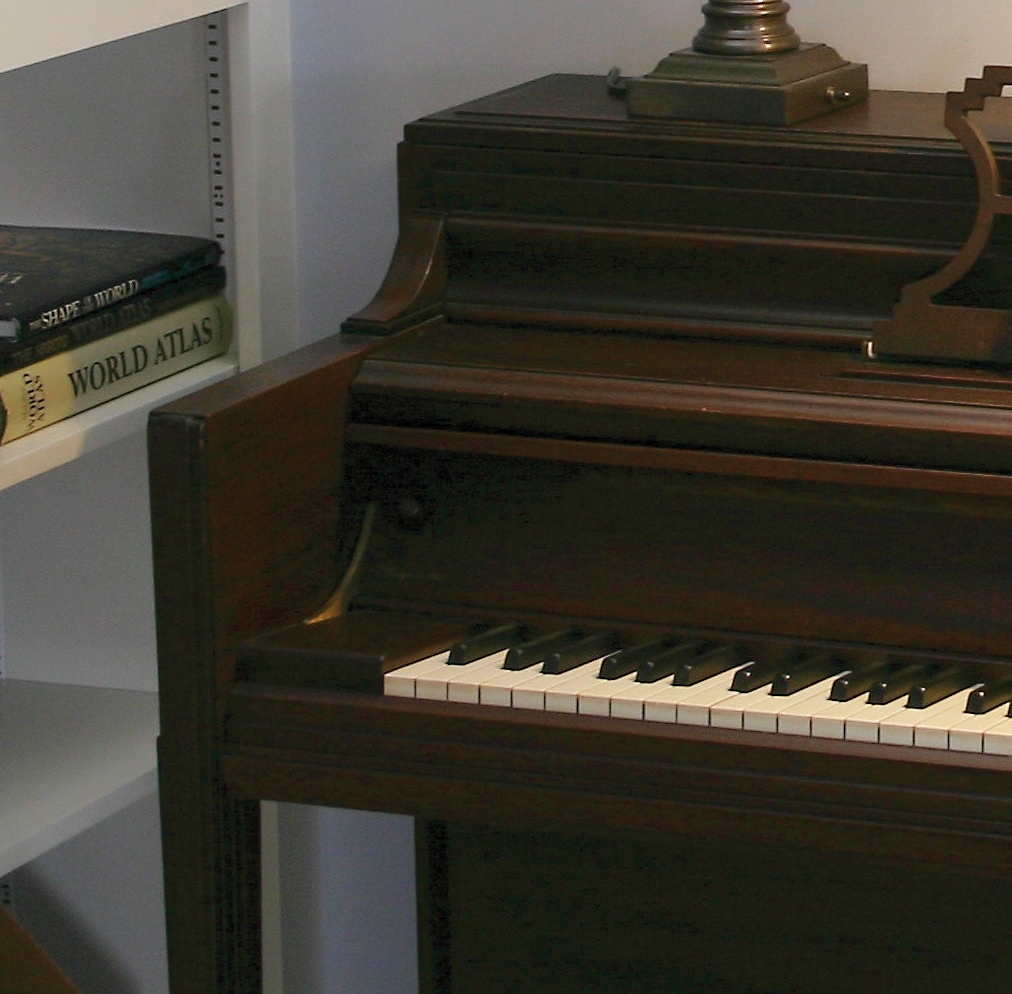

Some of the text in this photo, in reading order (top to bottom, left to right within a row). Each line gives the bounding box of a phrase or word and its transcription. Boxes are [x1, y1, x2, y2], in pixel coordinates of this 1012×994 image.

[41, 300, 80, 329] SHAPE
[93, 278, 140, 309] WORLD
[67, 344, 149, 398] WORLD
[154, 316, 214, 365] ATLAS
[22, 373, 46, 431] WORLD ATLAS
